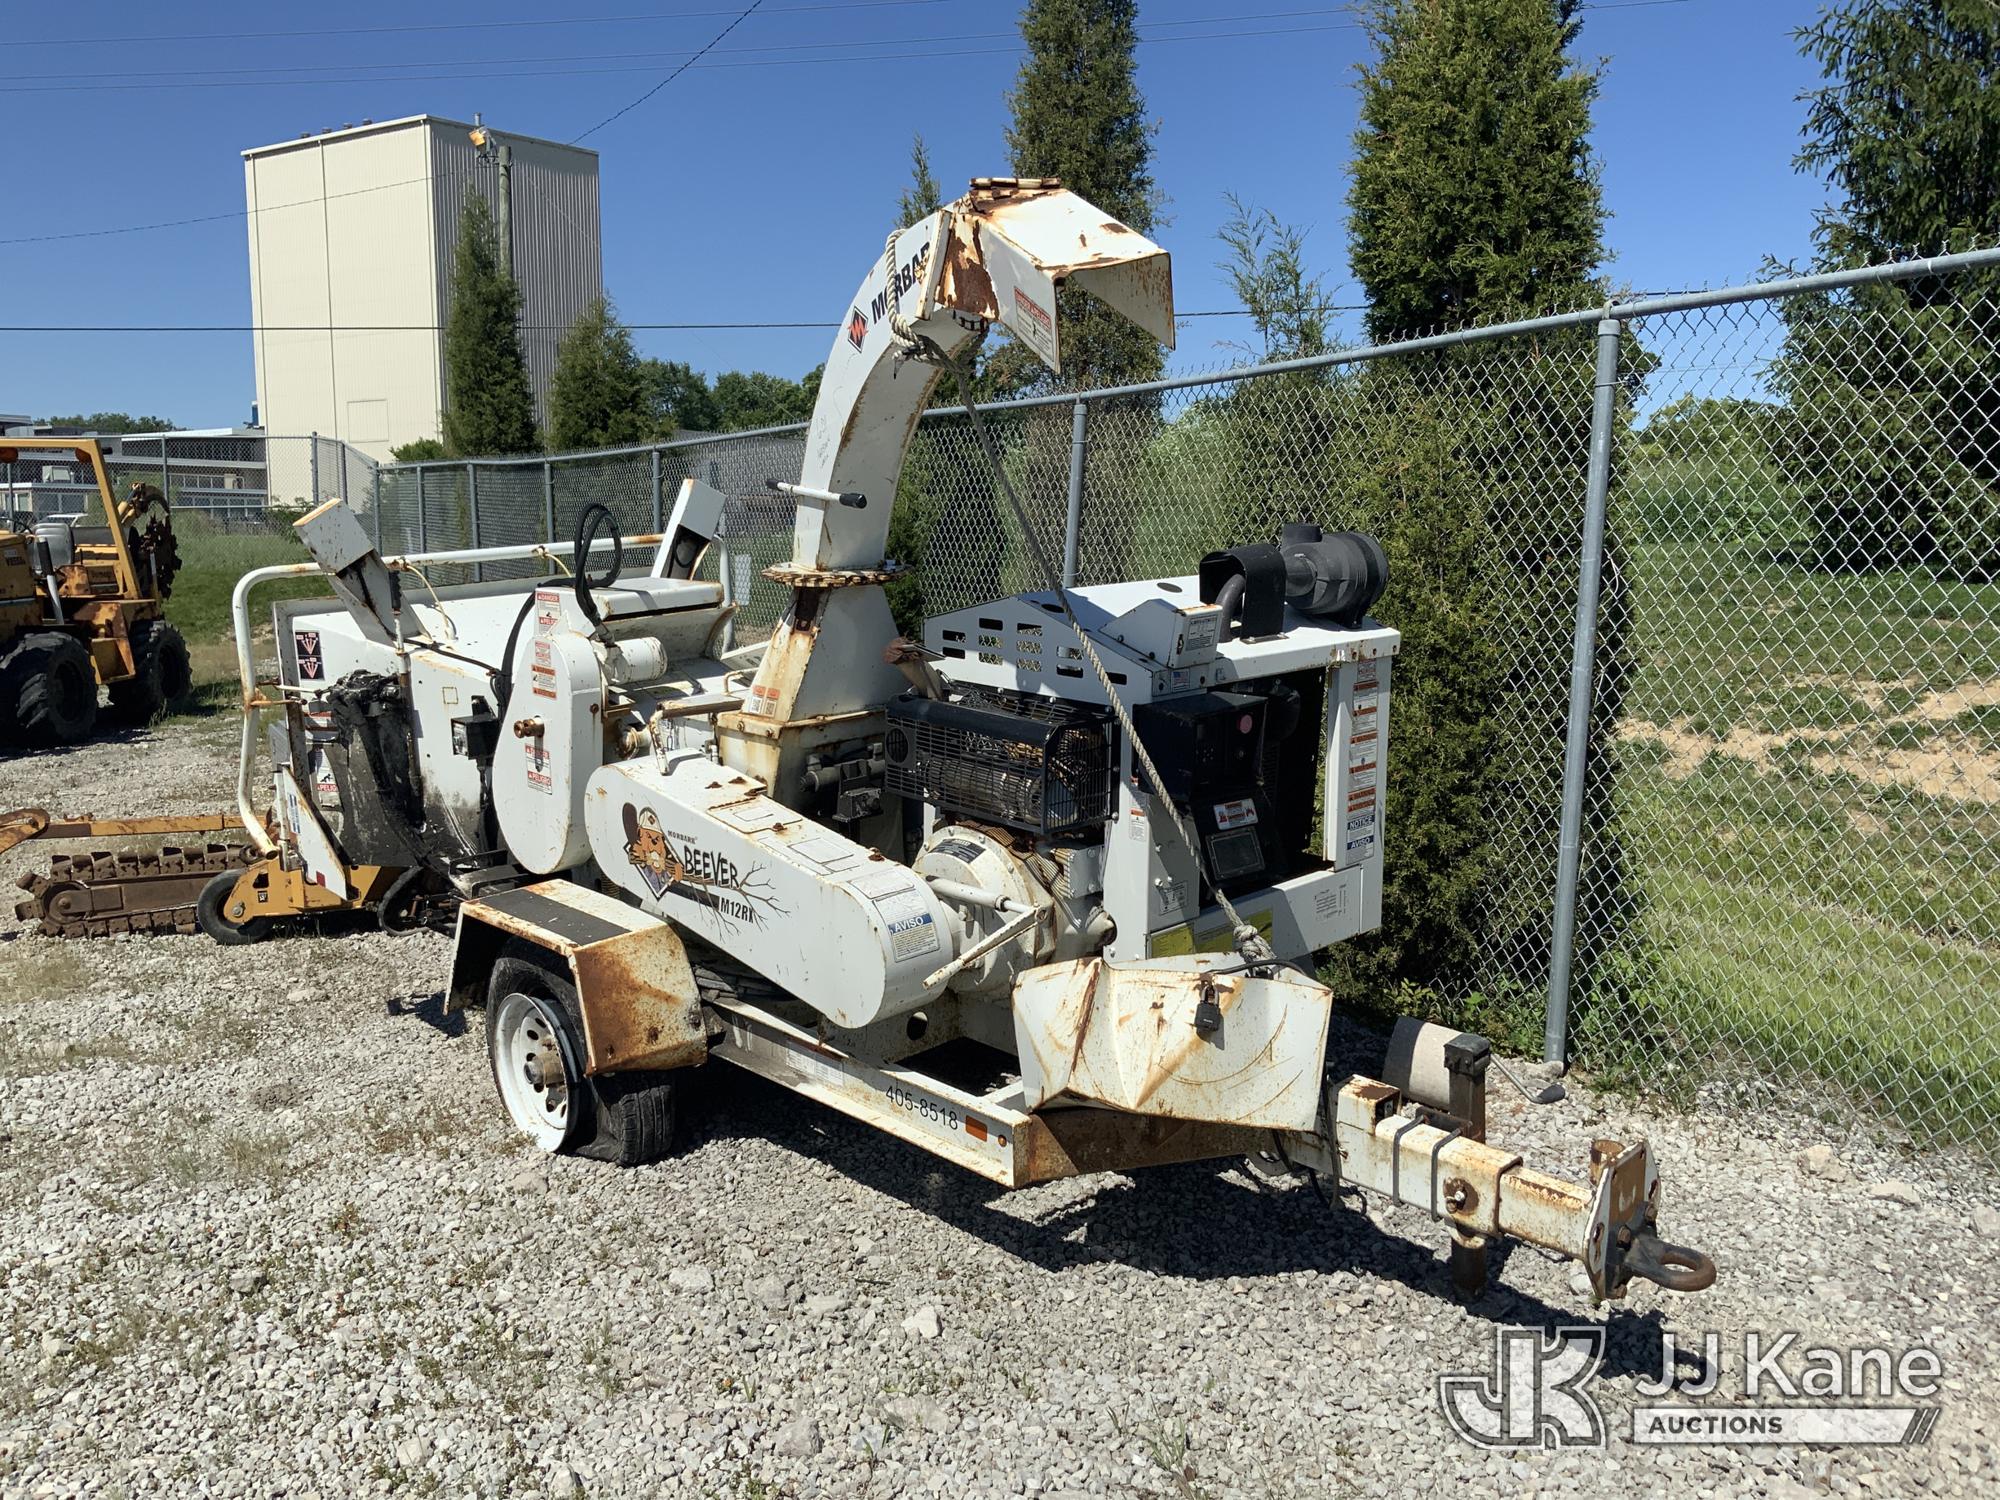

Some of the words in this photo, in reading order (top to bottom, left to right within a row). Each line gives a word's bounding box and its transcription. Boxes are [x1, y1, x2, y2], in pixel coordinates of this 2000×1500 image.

[684, 844, 740, 888] BEEVER
[894, 916, 924, 932] AVISO
[886, 1085, 958, 1130] 405-8518
